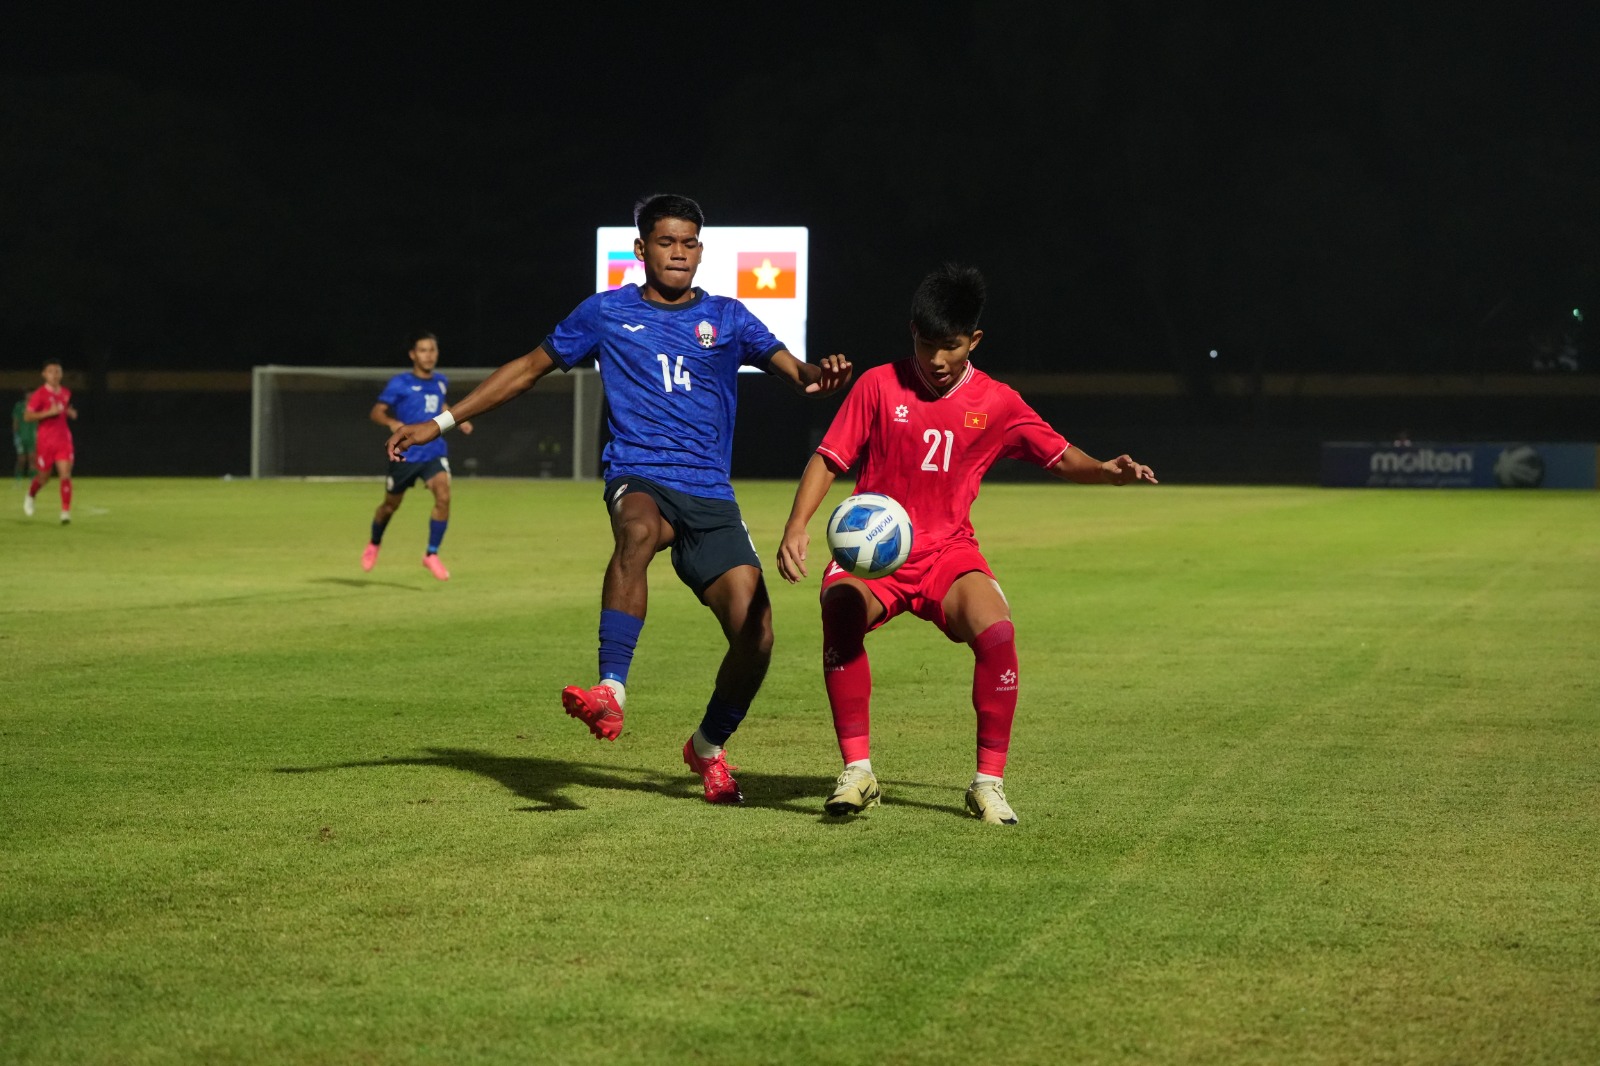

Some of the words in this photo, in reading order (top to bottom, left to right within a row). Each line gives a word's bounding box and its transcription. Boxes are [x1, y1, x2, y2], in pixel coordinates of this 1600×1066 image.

[657, 353, 692, 393] 14
[920, 428, 954, 473] 21
[1370, 448, 1473, 473] molten
[865, 514, 894, 542] molten
